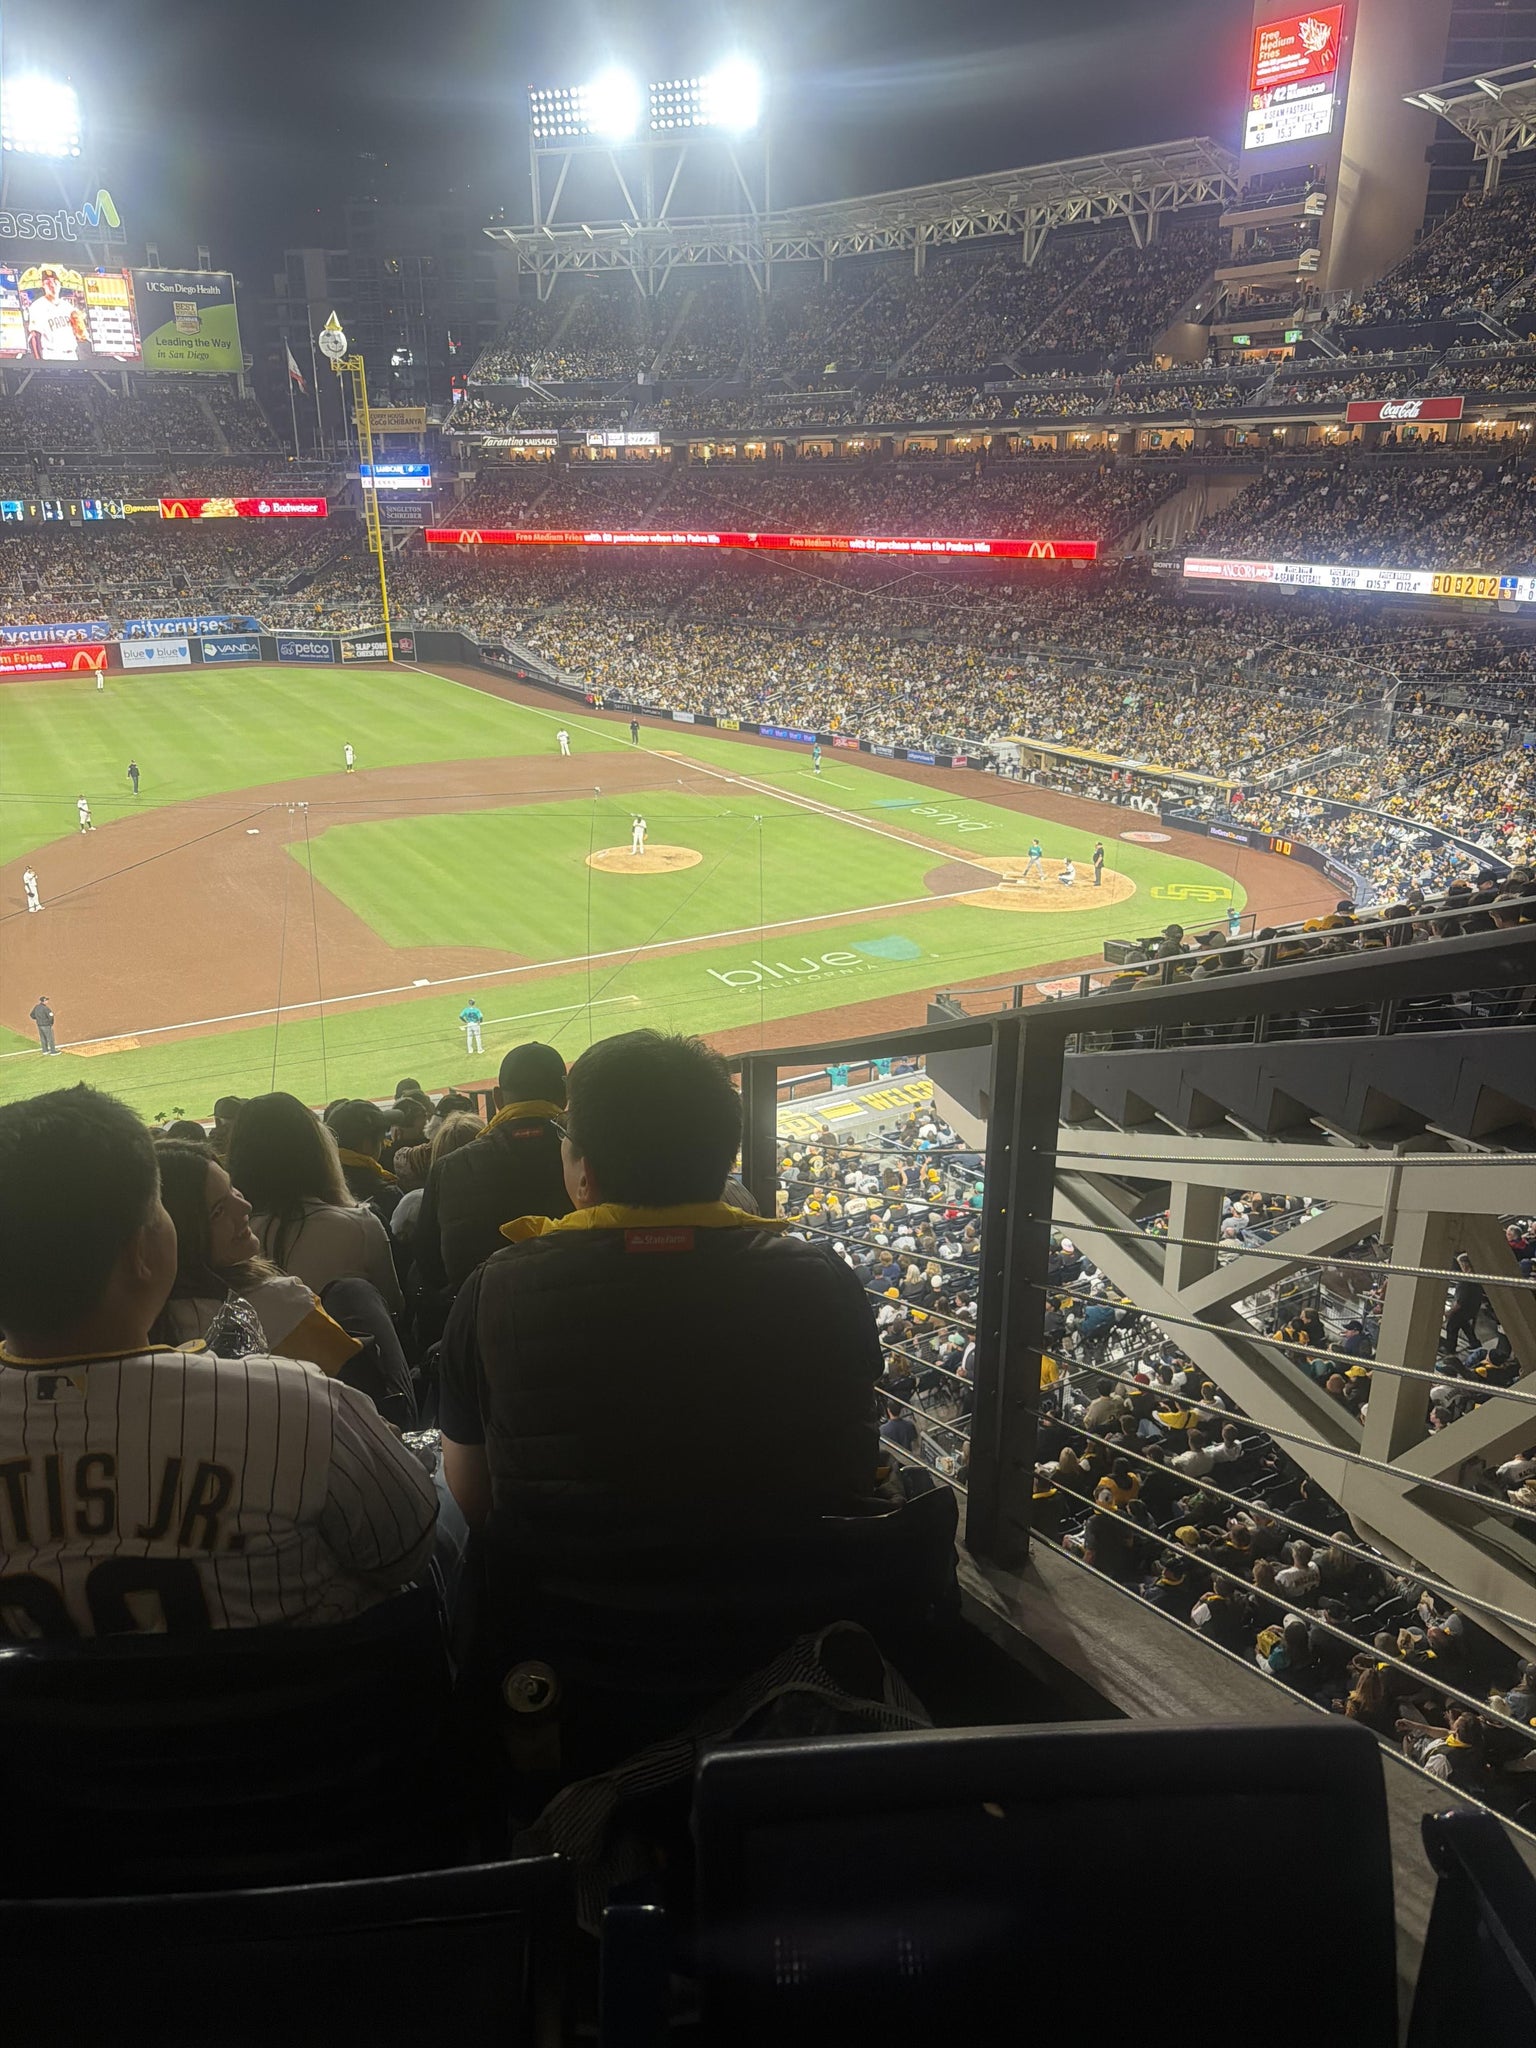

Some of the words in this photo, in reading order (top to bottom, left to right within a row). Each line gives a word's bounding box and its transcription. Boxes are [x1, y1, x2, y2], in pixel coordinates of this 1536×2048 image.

[1261, 30, 1280, 40] Free
[1260, 36, 1295, 51] Medium
[1259, 48, 1280, 61] Fries
[146, 282, 159, 292] UC
[160, 282, 174, 293] San
[175, 284, 196, 295] Diego
[196, 285, 221, 295] Health
[175, 303, 195, 311] BEST
[156, 336, 193, 348] Leading
[195, 337, 210, 347] the
[212, 338, 232, 349] Way
[158, 349, 166, 358] in
[169, 350, 184, 359] San
[187, 350, 209, 360] Diego
[482, 435, 524, 447] Tarantino
[525, 436, 557, 446] SAUSAGES
[273, 502, 318, 513] Budweiser
[515, 532, 533, 542] Free
[565, 533, 583, 542] Fries
[789, 537, 804, 547] Free
[805, 538, 831, 548] Medium
[832, 538, 849, 548] Fries
[1295, 574, 1322, 585] FASTBALL
[1332, 577, 1340, 586] 93
[1341, 578, 1356, 587] MPH
[1465, 576, 1474, 595] 2
[1488, 577, 1498, 596] 2
[217, 643, 259, 653] VANDA
[295, 641, 329, 656] petco
[355, 643, 371, 651] SLAP
[14, 652, 44, 663] Fries
[124, 649, 145, 659] blue
[157, 647, 178, 657] blue
[706, 951, 863, 987] blue
[739, 964, 880, 994] CALIFORNIA
[836, 1069, 846, 1077] 42
[137, 1457, 247, 1550] JR.
